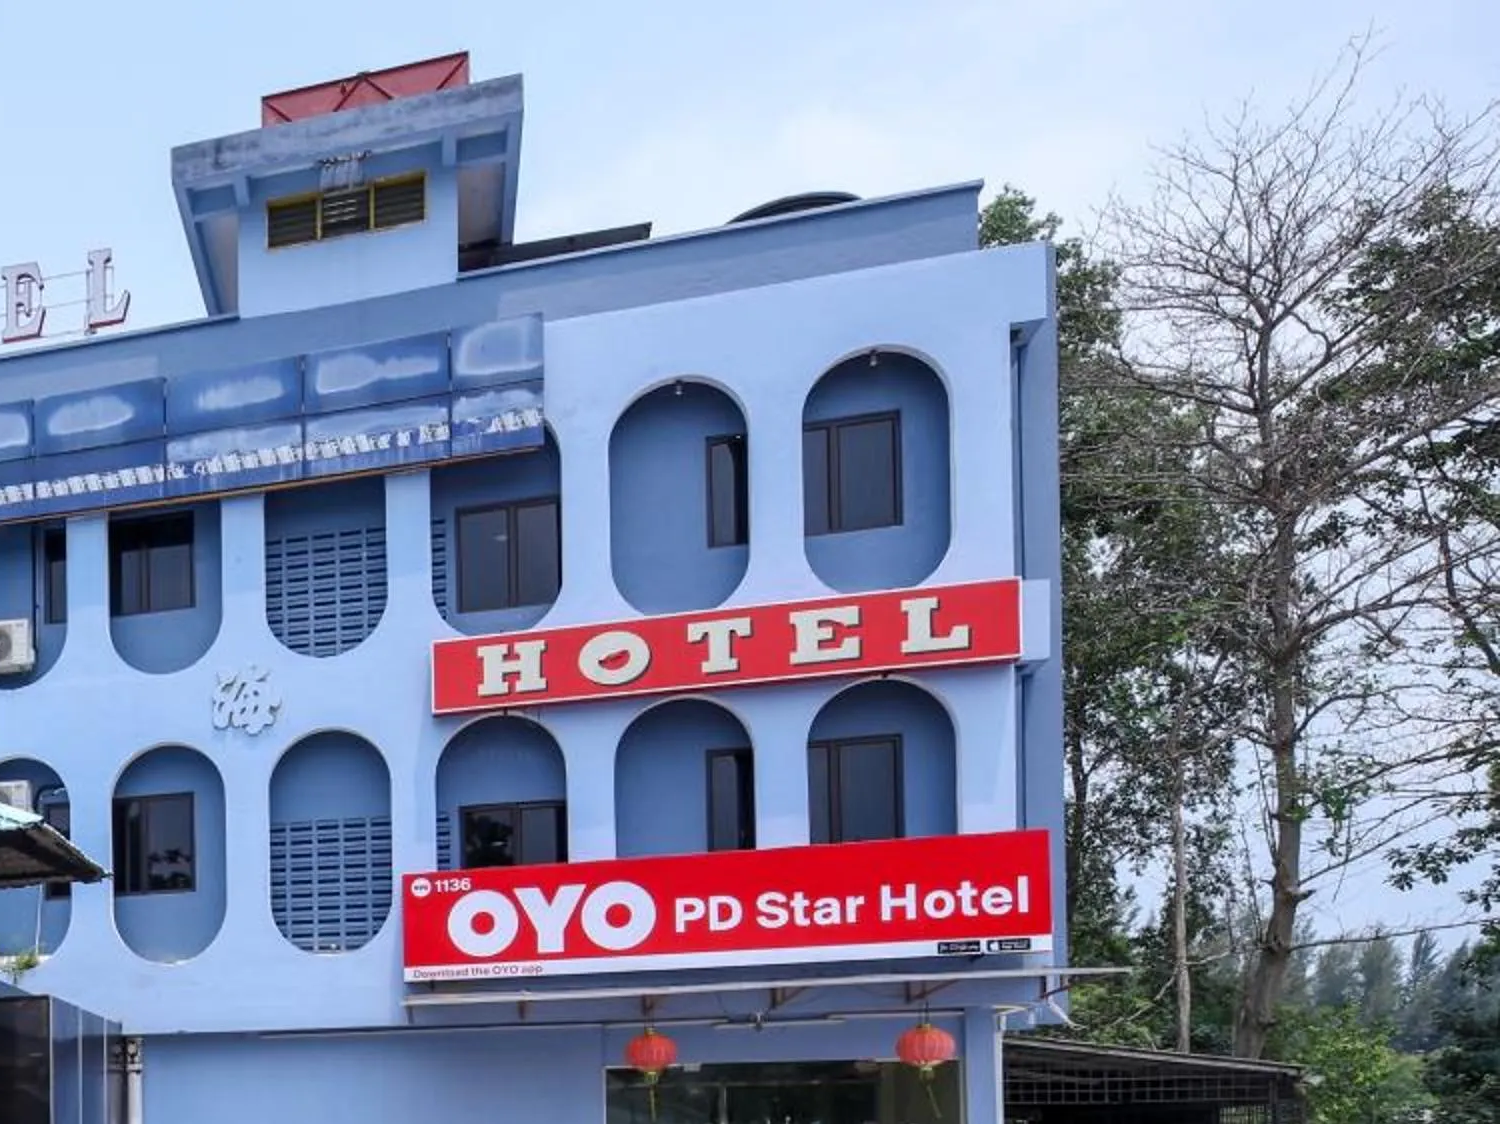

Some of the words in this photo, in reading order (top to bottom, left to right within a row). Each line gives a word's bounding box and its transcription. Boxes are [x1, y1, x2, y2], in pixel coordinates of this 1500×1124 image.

[477, 596, 971, 697] HOTEL
[434, 878, 471, 893] 1136
[447, 881, 656, 957] OYO
[675, 895, 743, 933] PD
[756, 890, 865, 930] Star
[880, 875, 1030, 922] Hotel
[492, 965, 519, 975] OYO
